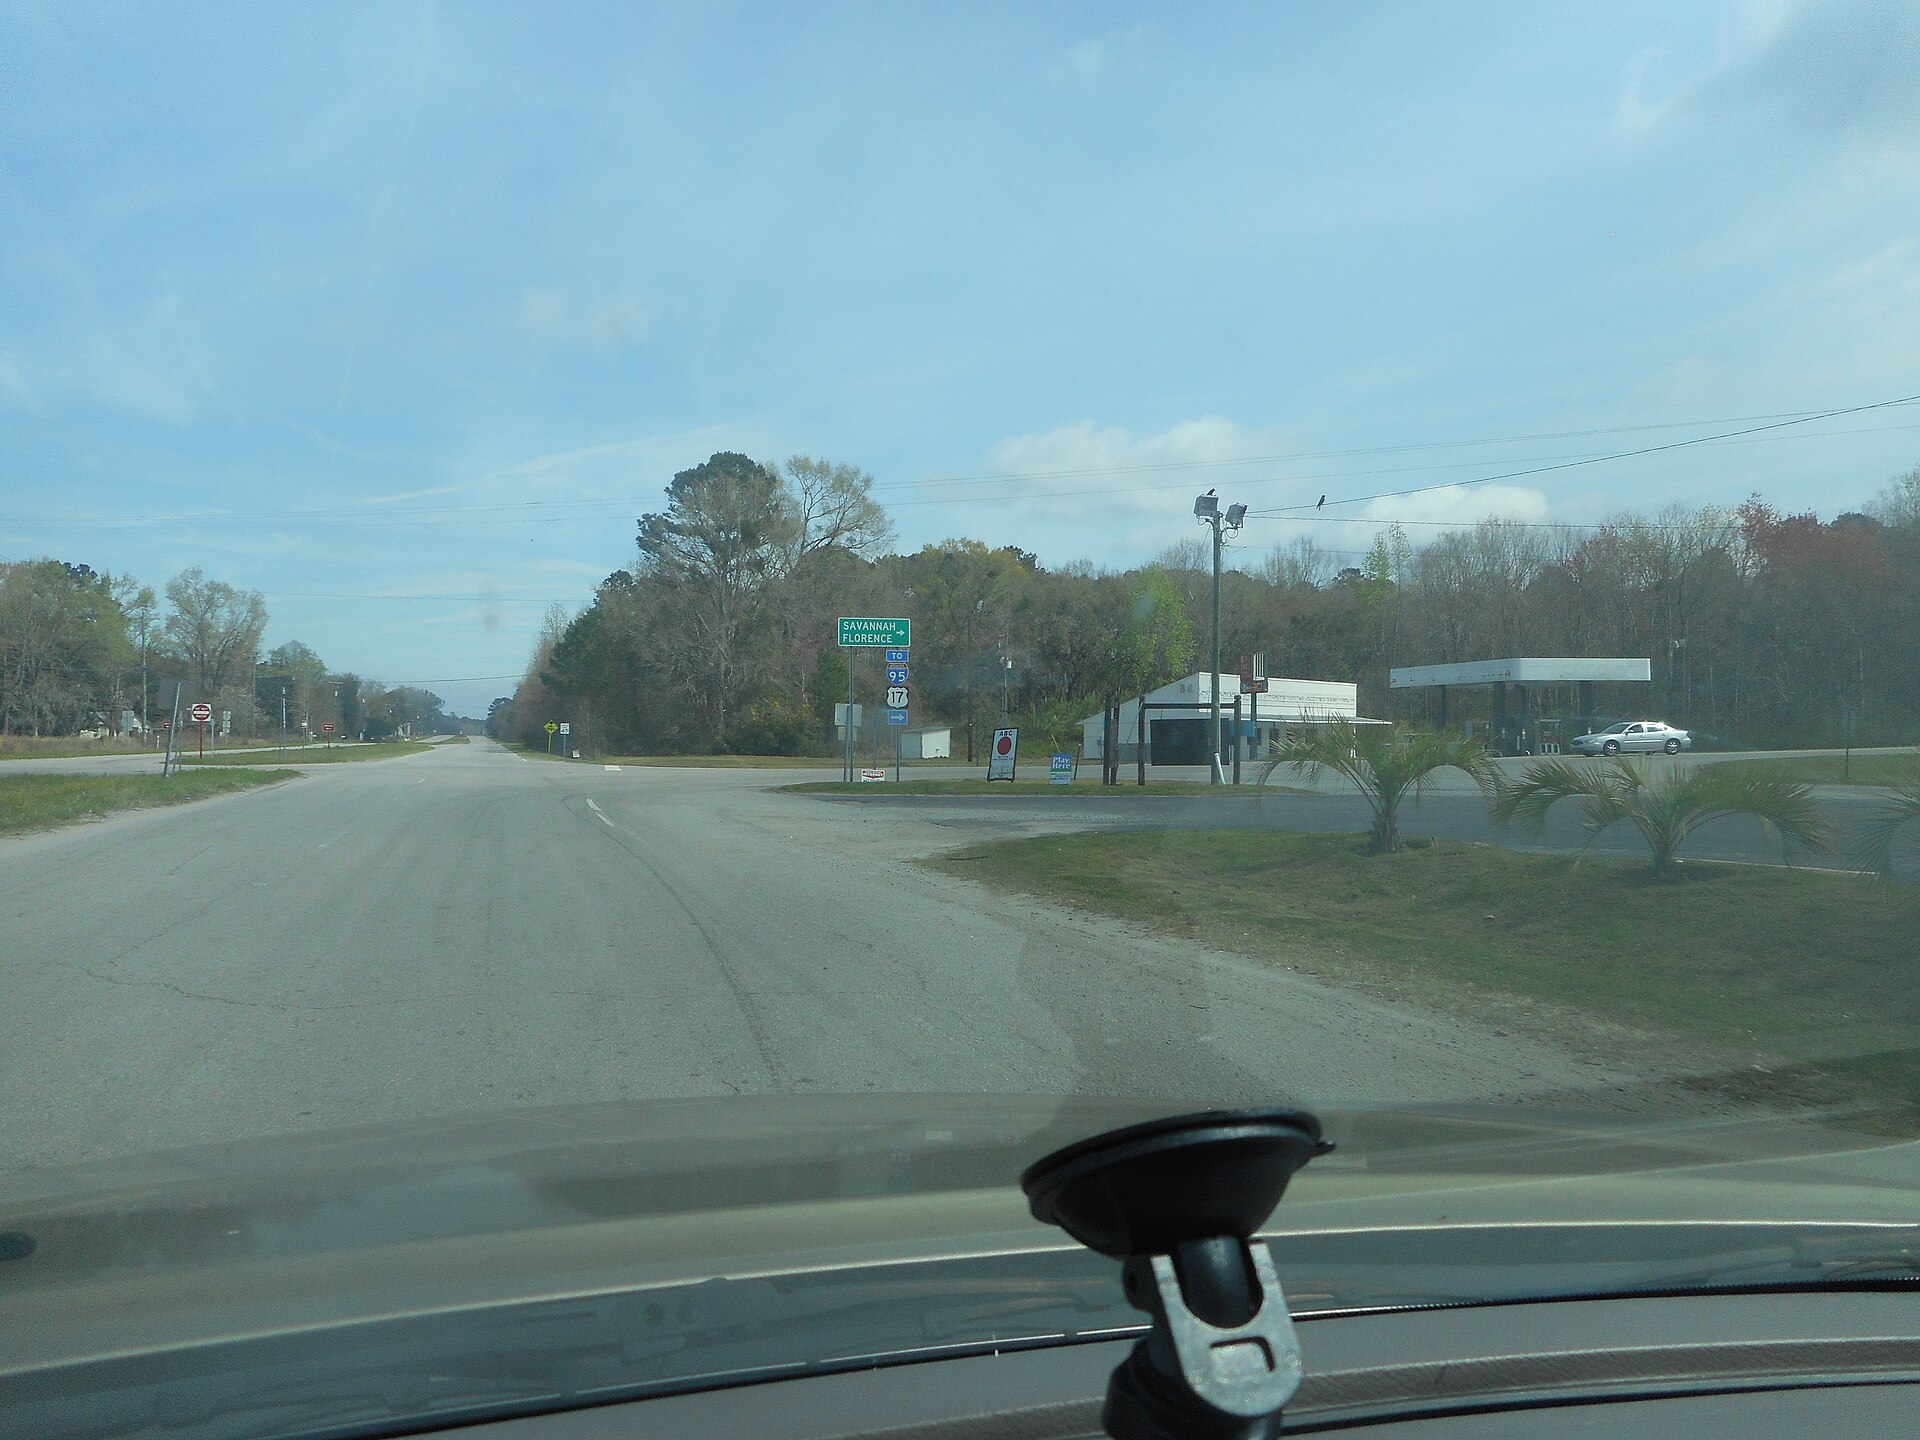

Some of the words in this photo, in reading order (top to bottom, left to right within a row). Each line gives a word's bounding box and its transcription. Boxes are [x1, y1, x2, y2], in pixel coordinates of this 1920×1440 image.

[843, 621, 896, 631] SAVANNAH
[843, 633, 893, 643] FLORENCE
[891, 652, 903, 660] TO
[889, 671, 906, 682] 95
[891, 691, 904, 704] 17
